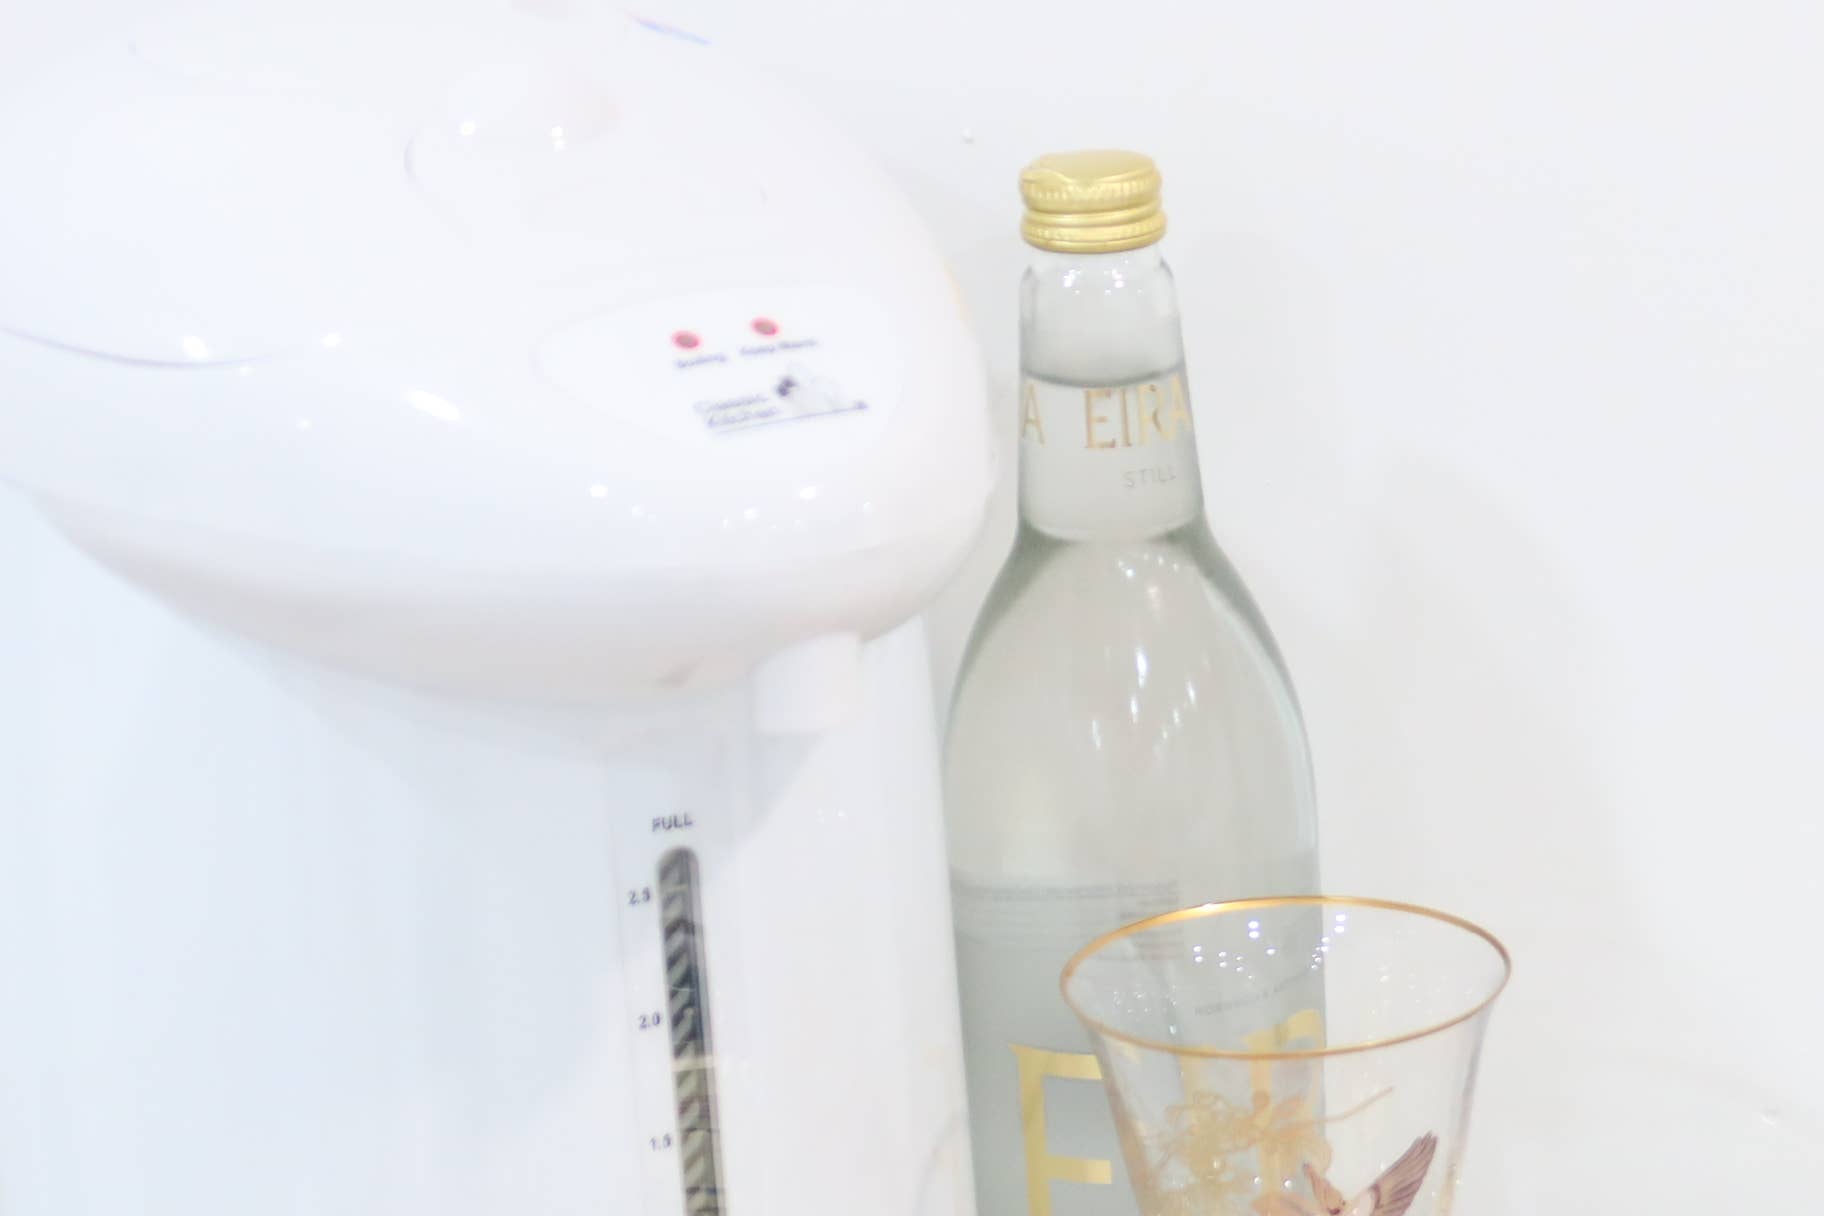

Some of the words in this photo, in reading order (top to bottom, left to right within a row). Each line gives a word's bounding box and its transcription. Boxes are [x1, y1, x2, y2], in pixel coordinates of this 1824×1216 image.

[1083, 373, 1191, 450] EIRA
[1122, 463, 1177, 489] STILL
[651, 812, 693, 832] FULL
